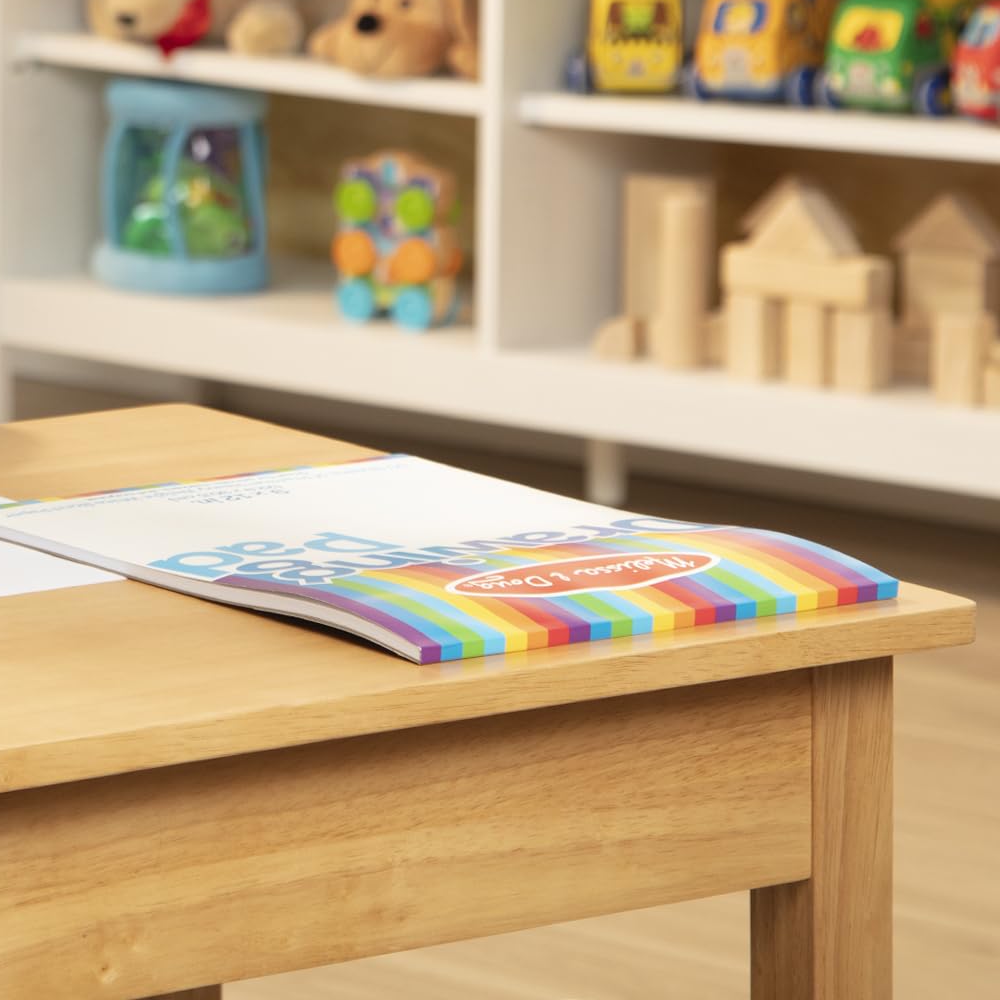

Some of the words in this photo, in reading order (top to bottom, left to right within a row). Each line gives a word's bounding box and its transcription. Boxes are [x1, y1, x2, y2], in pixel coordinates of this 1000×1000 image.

[236, 517, 720, 585] Drawing
[572, 555, 698, 578] Melissa
[474, 573, 553, 592] Doug
